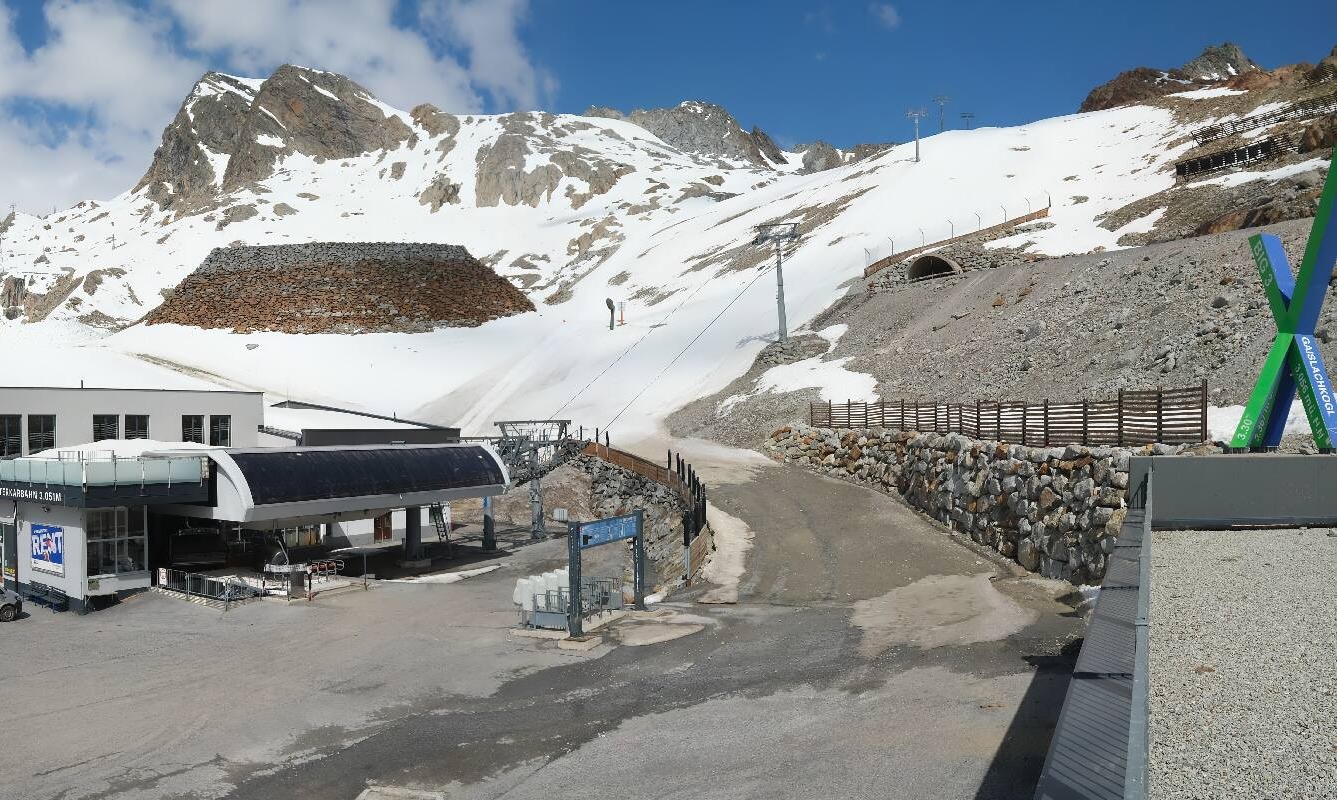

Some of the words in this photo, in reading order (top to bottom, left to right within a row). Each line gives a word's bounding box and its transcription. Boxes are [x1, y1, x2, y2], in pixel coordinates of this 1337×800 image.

[1254, 240, 1268, 273] BIG
[1265, 274, 1273, 287] 3
[1302, 336, 1335, 417] GAISLACHKOGL
[31, 532, 62, 555] RENT
